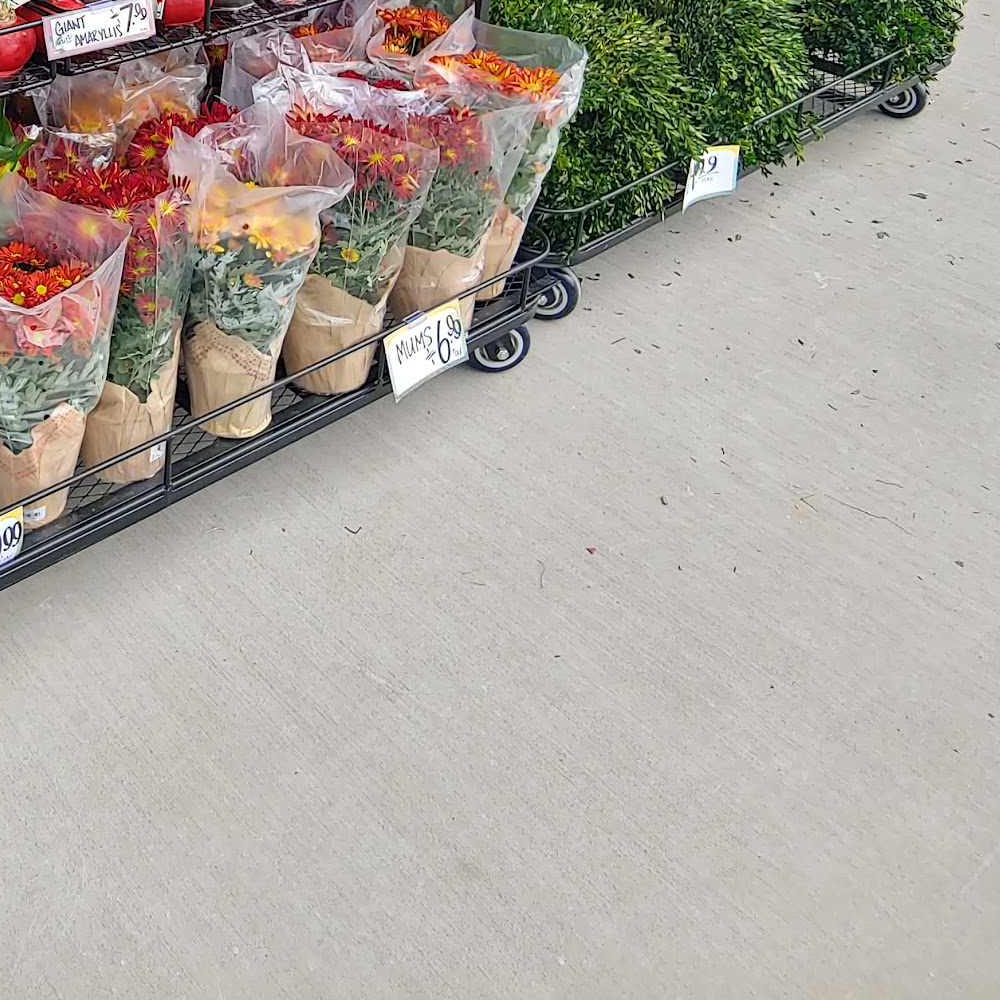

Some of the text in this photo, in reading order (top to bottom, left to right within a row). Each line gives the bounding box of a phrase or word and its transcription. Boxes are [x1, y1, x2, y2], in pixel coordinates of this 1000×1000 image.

[55, 15, 86, 36] GIANT
[75, 24, 123, 47] AMARYLLIS
[396, 326, 433, 366] MUMS
